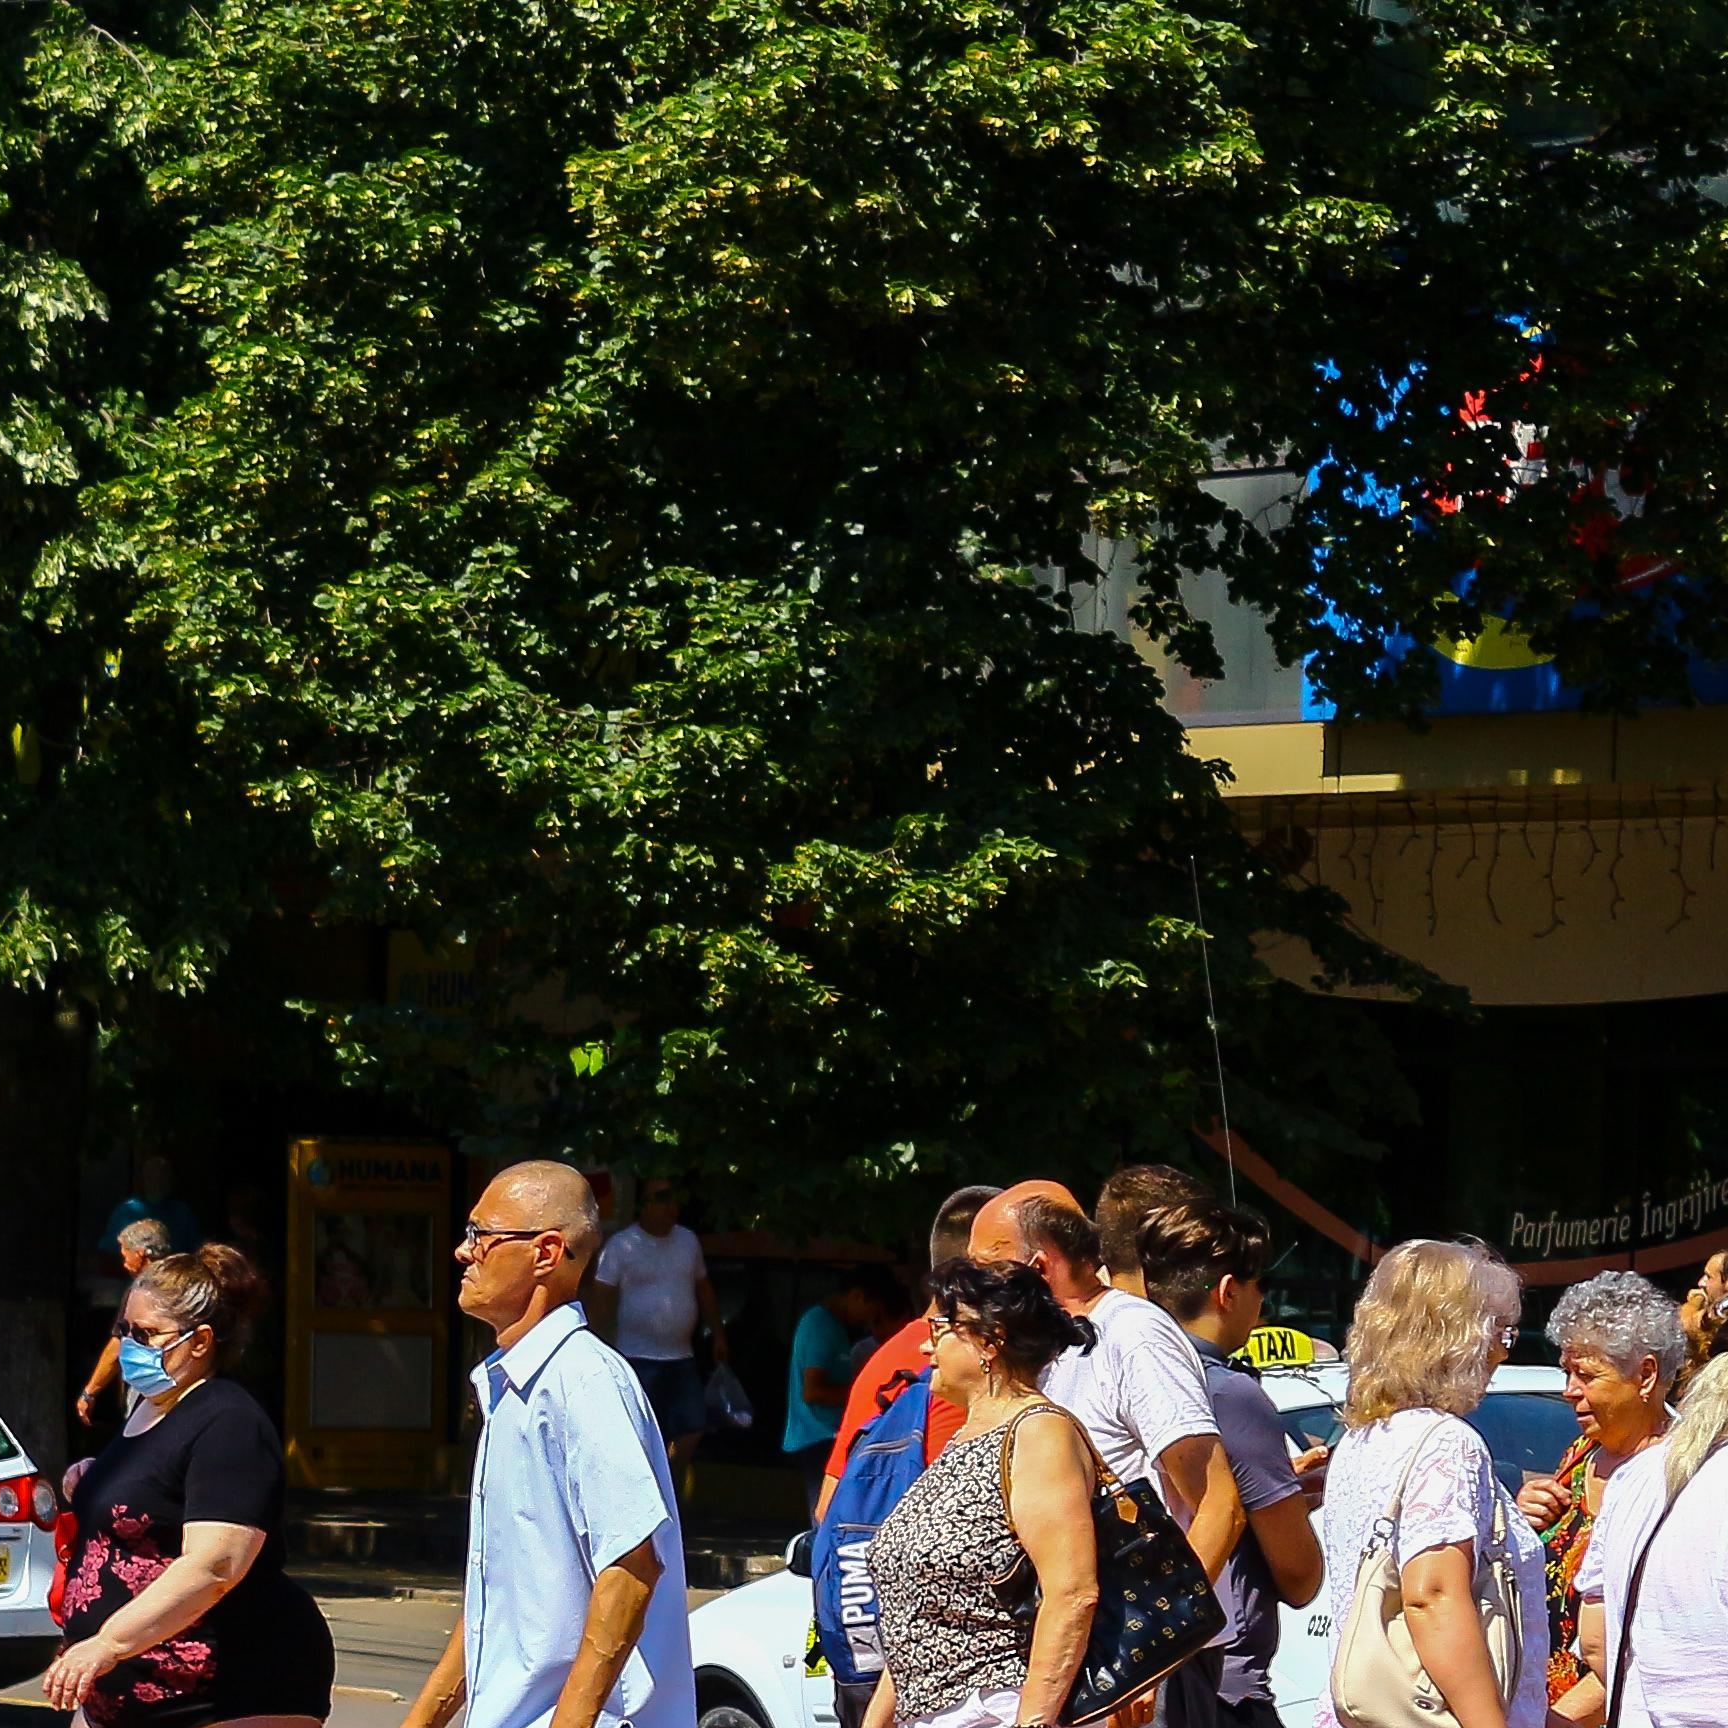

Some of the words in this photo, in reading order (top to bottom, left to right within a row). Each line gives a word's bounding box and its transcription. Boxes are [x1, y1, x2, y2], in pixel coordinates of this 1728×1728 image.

[338, 1159, 442, 1181] HUMANA
[1510, 1203, 1632, 1257] Parfumerie
[1251, 1331, 1296, 1362] TAXI
[836, 1540, 877, 1626] PUMA
